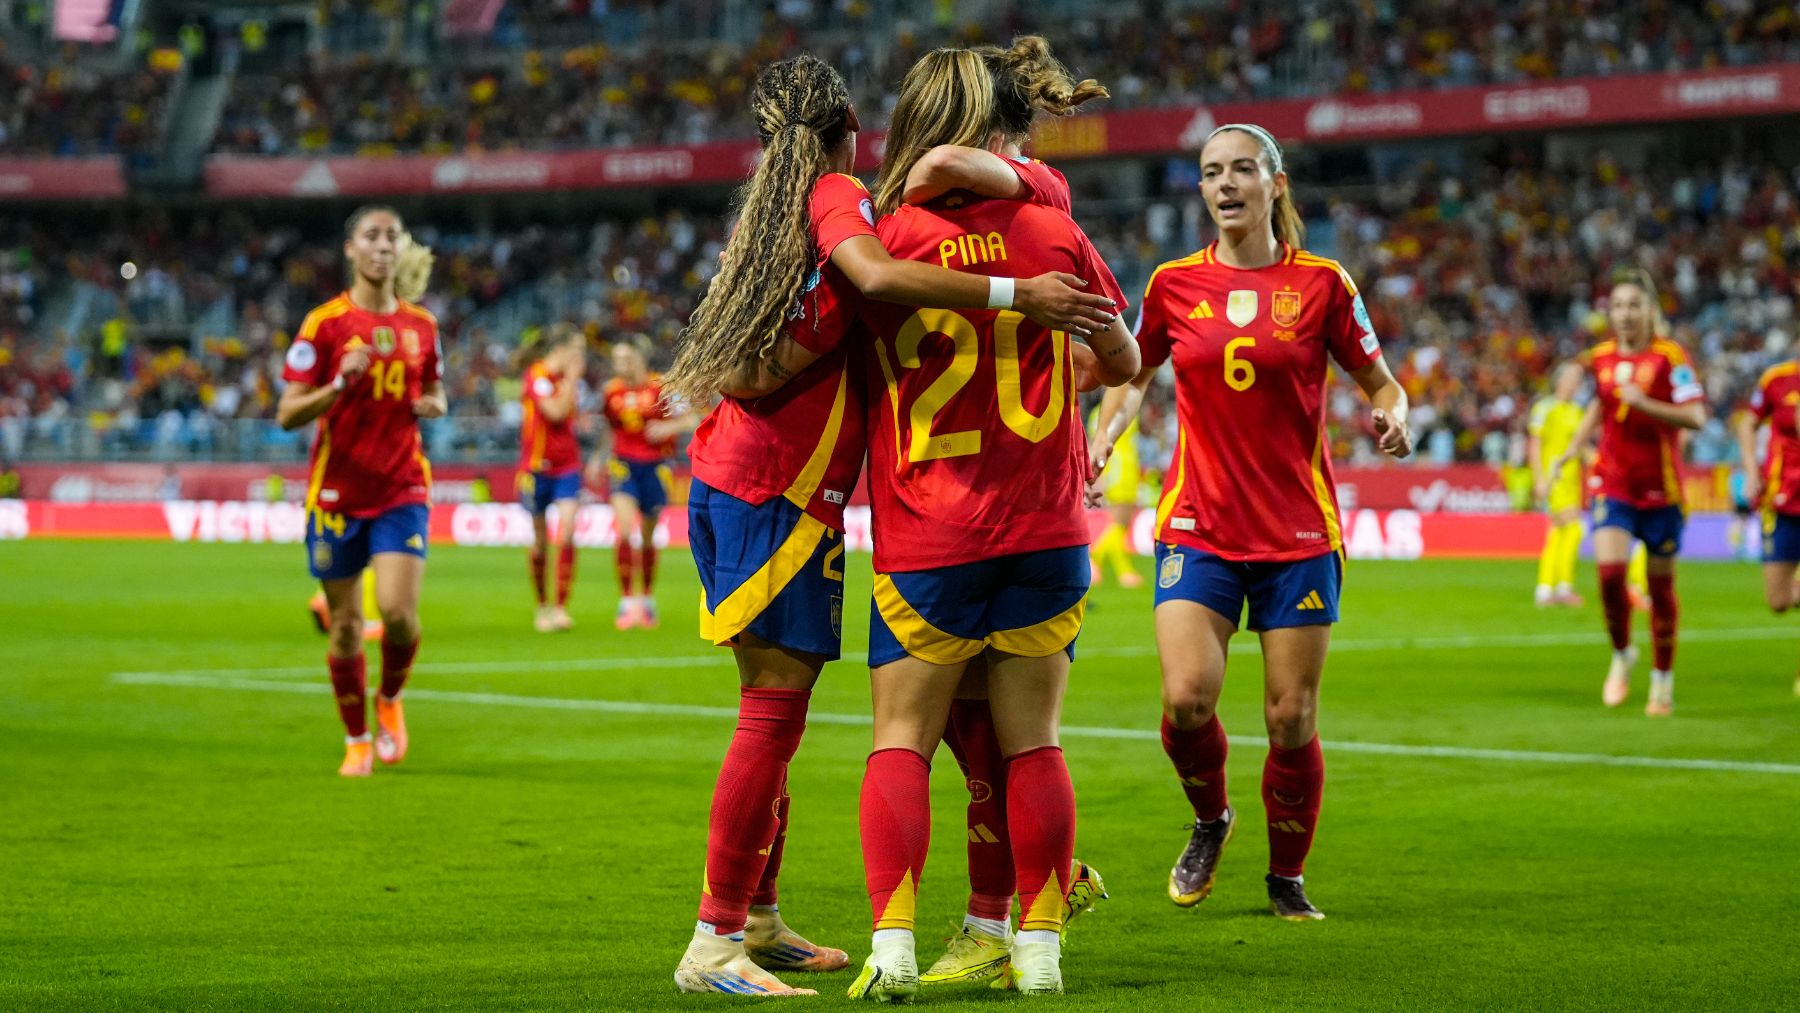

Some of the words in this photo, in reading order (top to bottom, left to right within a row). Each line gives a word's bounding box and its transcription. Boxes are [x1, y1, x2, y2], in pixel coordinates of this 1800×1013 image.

[939, 232, 1007, 268] PINA
[369, 360, 406, 401] 14
[1224, 337, 1256, 392] 6
[895, 308, 1065, 463] 20
[161, 501, 306, 541] VICTO
[314, 505, 346, 538] 14
